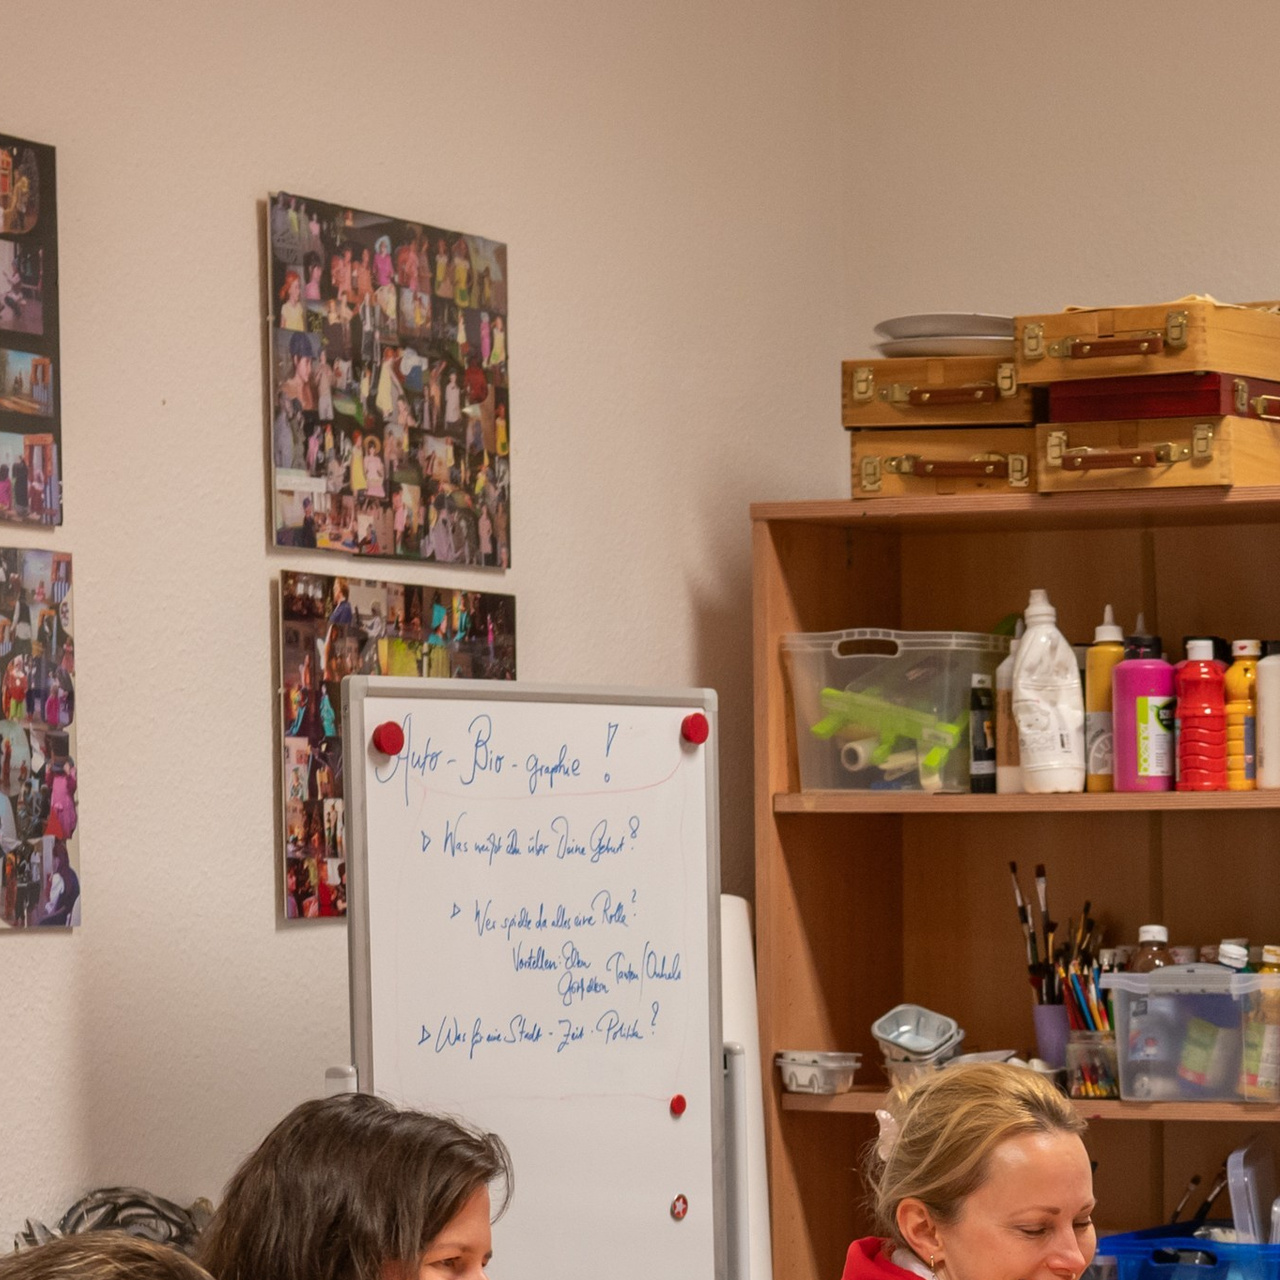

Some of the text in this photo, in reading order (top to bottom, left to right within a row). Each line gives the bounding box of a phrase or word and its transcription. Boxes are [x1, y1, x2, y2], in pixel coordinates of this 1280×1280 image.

[460, 714, 505, 785] Bio
[444, 812, 468, 857] Was
[475, 899, 496, 936] Wer
[435, 1015, 467, 1053] Was
